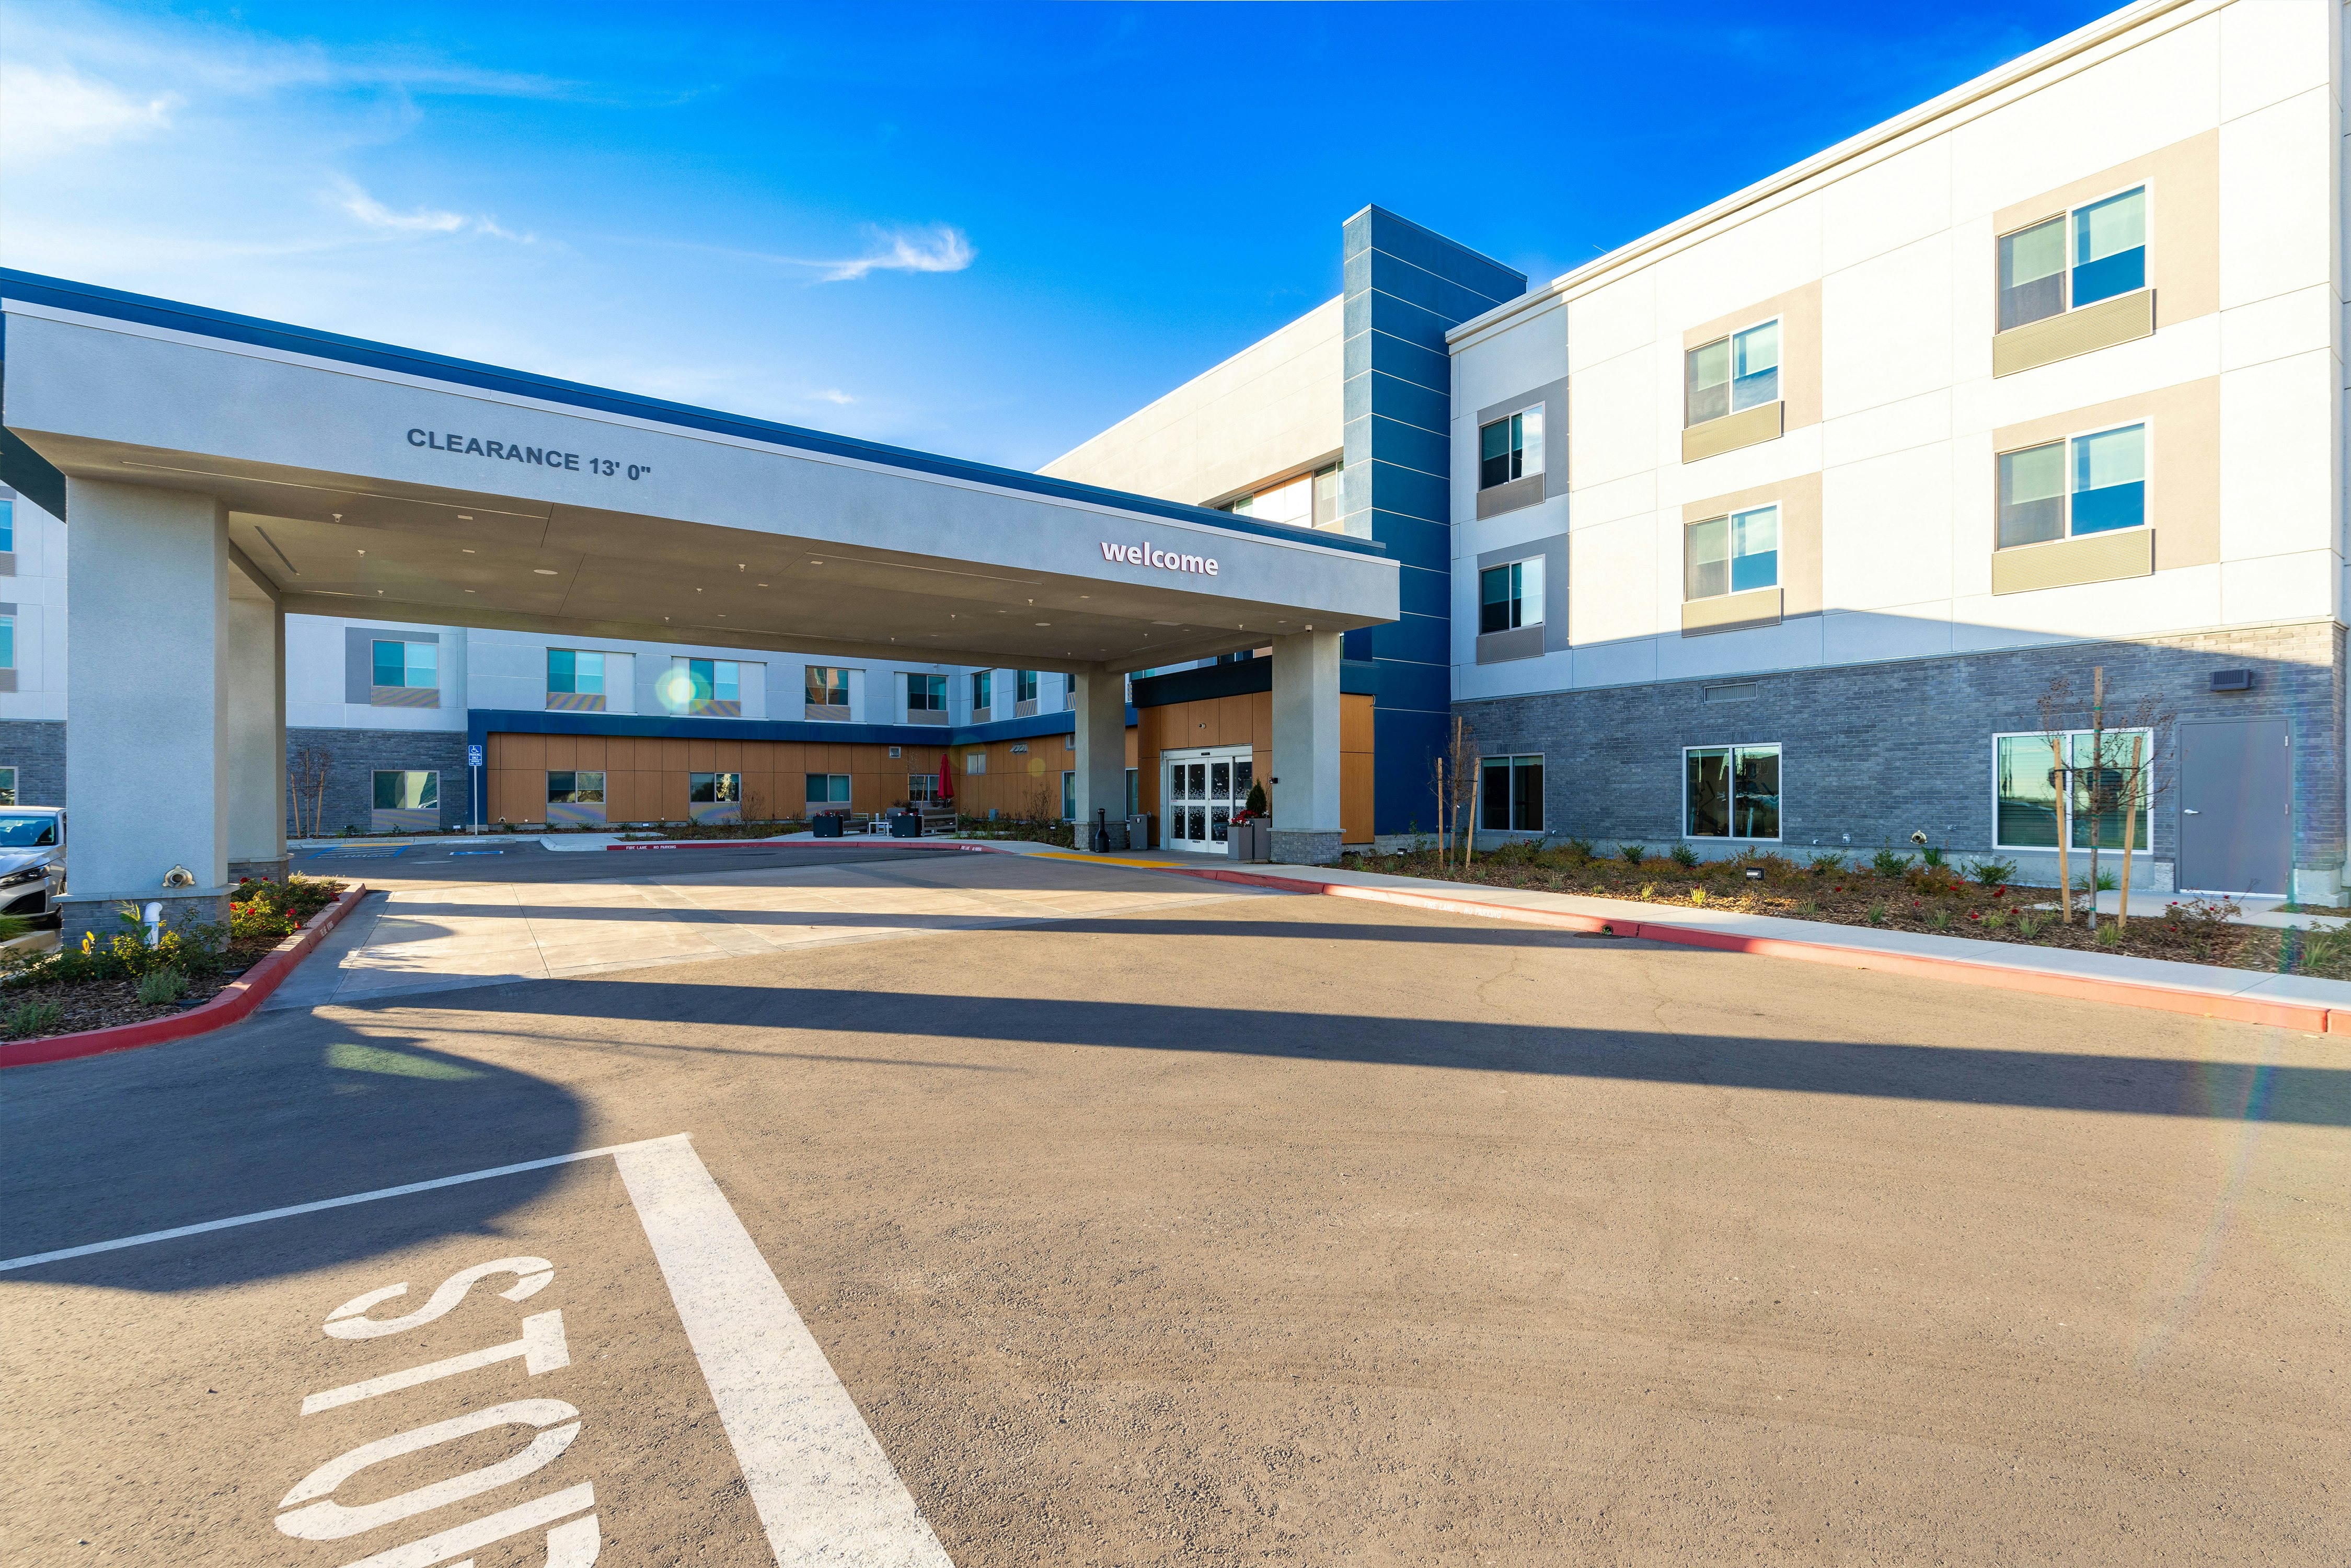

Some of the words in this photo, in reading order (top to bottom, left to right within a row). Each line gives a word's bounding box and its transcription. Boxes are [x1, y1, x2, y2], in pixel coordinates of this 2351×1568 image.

[407, 428, 579, 471] CLEARANCE
[589, 457, 620, 477] 13'
[628, 464, 651, 481] 0"
[1100, 541, 1219, 575] welcome
[1439, 903, 1455, 912] LANE
[1475, 908, 1502, 918] PARKING
